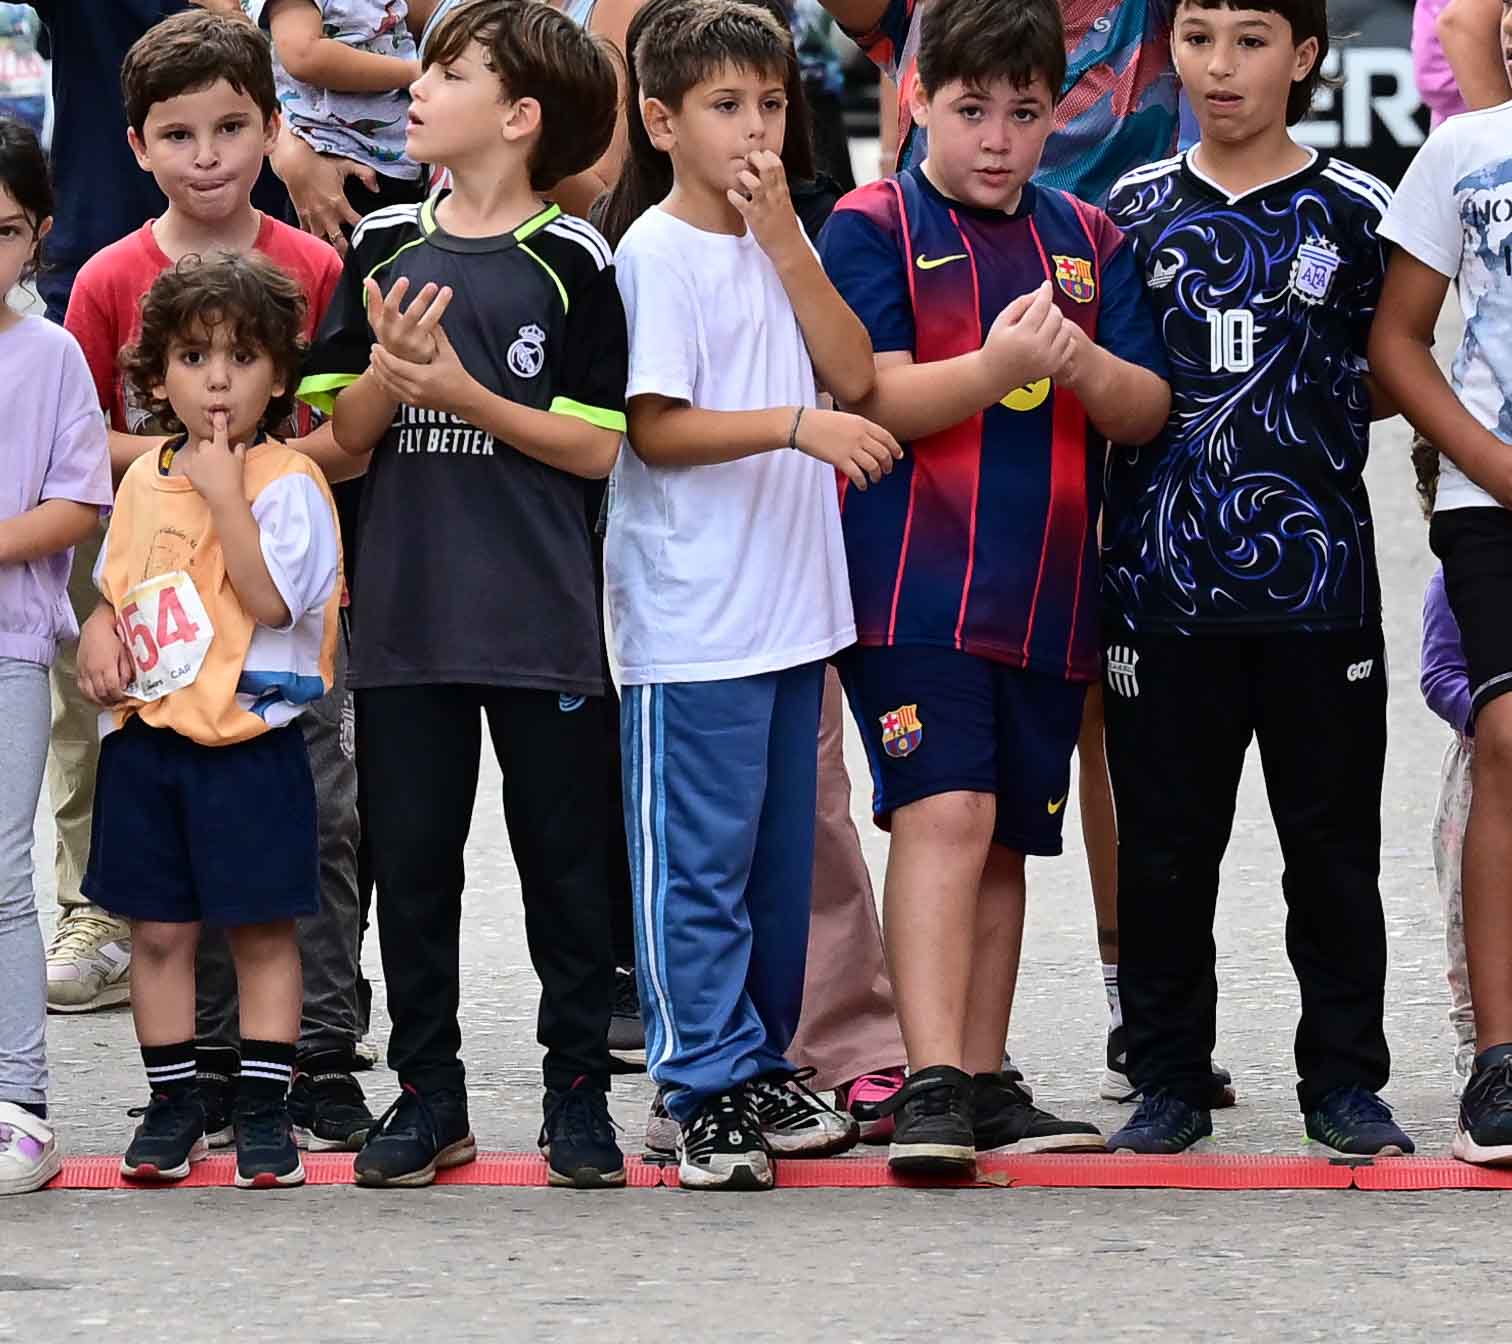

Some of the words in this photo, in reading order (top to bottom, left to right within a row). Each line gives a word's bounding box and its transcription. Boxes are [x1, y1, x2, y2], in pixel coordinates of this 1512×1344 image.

[1206, 308, 1254, 373] 10
[398, 428, 424, 454] FLY
[427, 427, 495, 456] BETTER
[118, 586, 201, 673] 54
